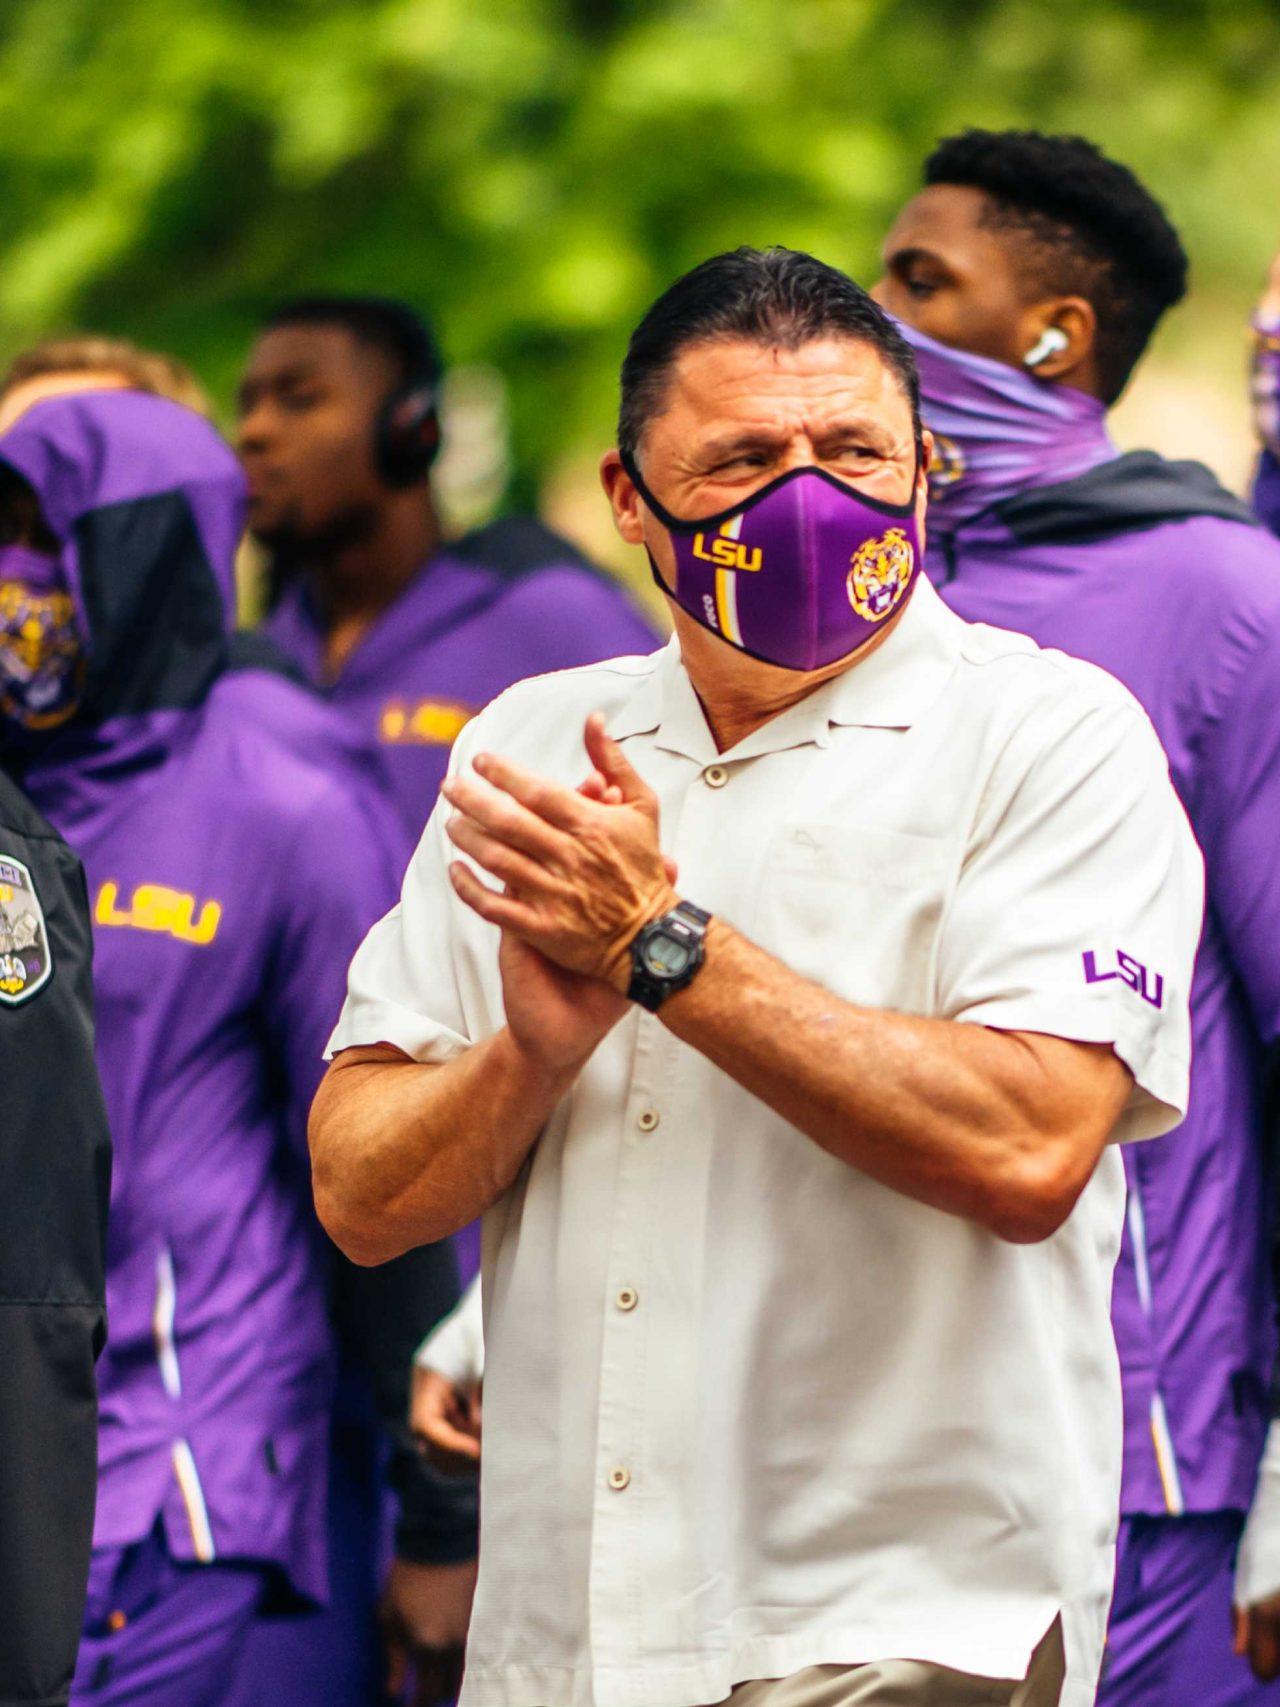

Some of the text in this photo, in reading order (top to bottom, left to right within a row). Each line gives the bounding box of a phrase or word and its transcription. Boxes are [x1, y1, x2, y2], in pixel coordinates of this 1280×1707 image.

[693, 533, 763, 572] LSU
[95, 882, 222, 945] LSU
[1082, 949, 1164, 1009] LSU
